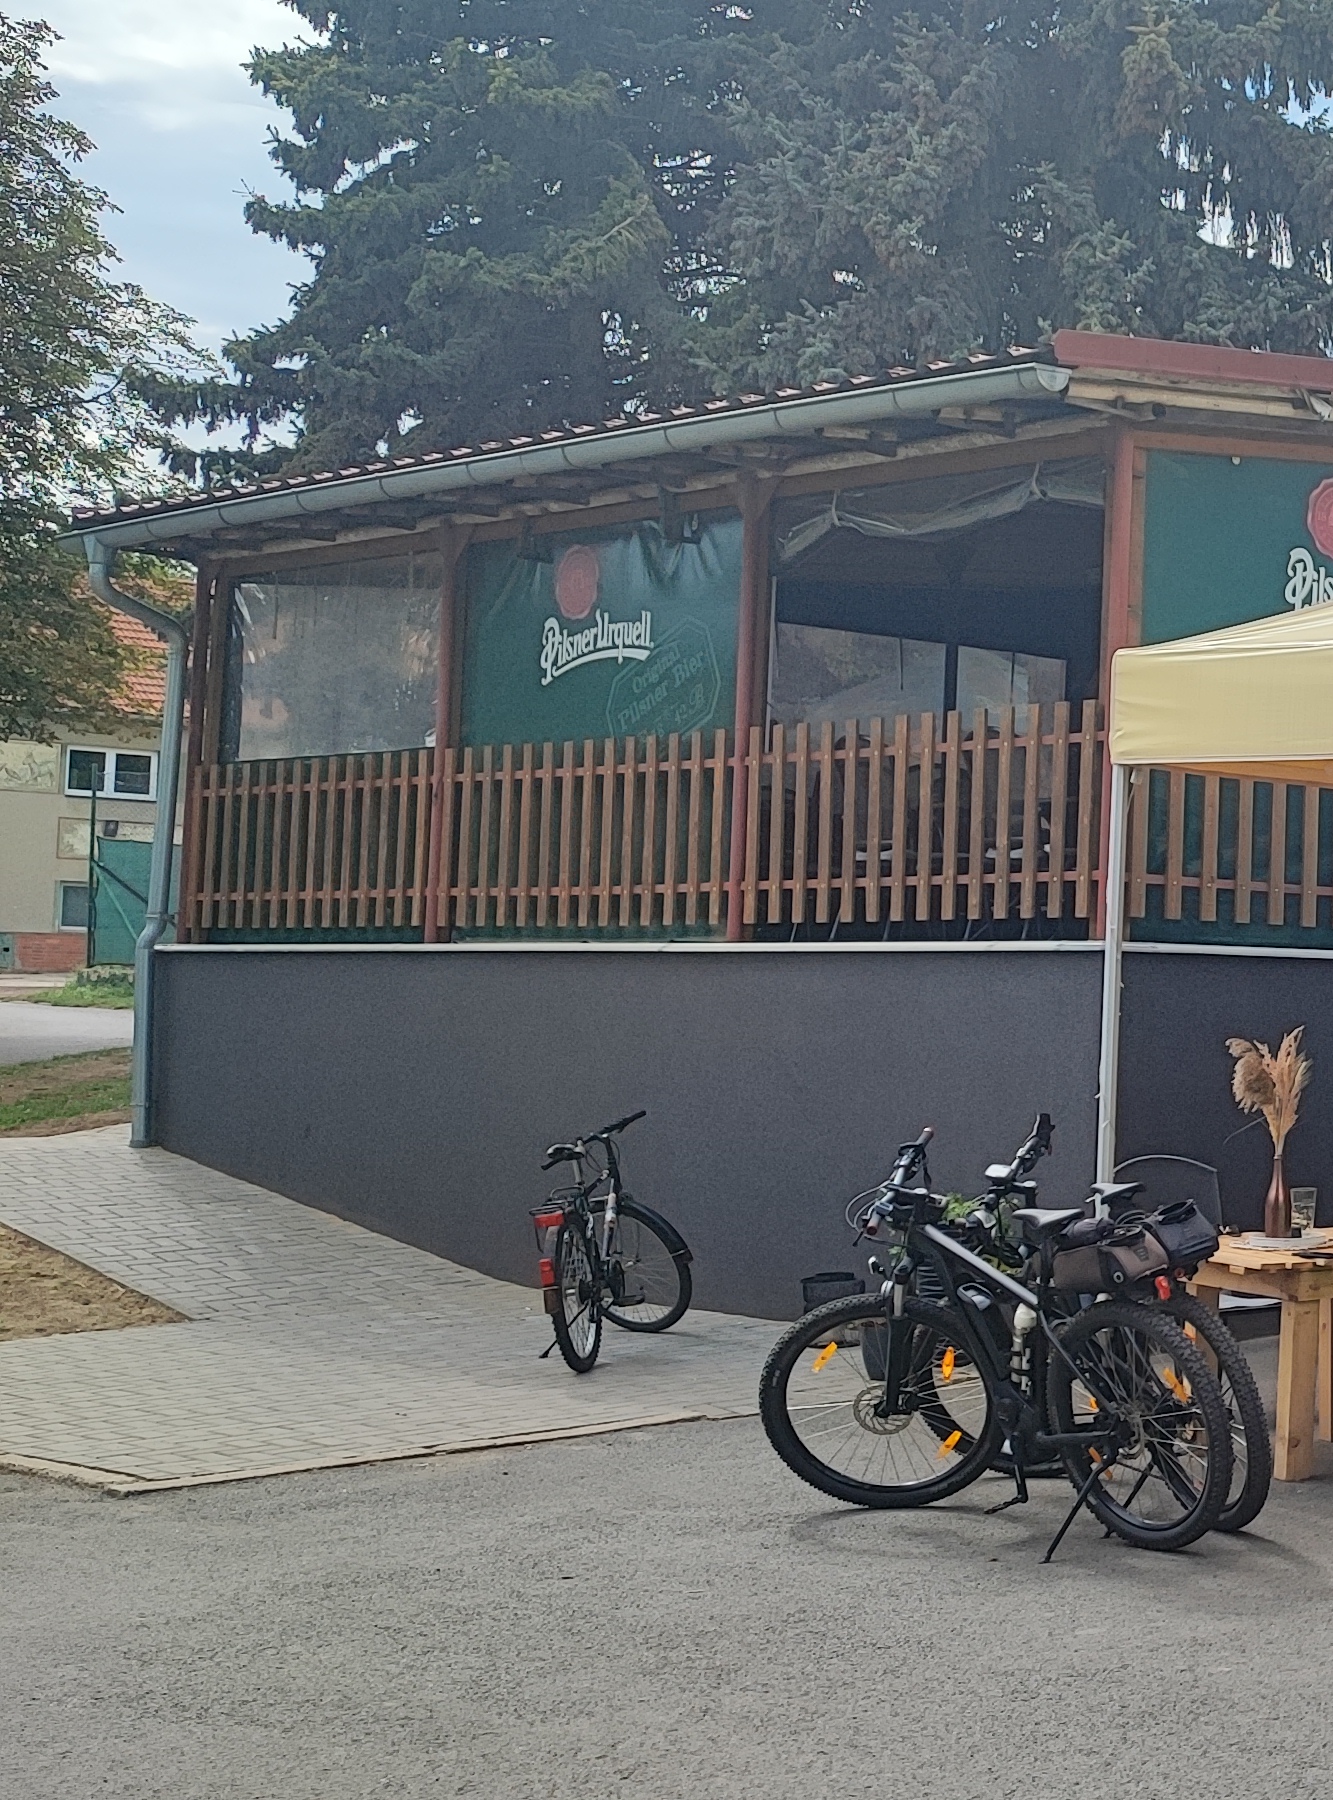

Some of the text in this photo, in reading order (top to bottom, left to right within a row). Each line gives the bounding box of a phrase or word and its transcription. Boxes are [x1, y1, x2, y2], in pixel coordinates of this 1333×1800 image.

[540, 608, 652, 687] Pilsner Urquell
[632, 643, 681, 694] Original
[617, 680, 669, 733] Pilsner
[672, 650, 704, 689] Bier
